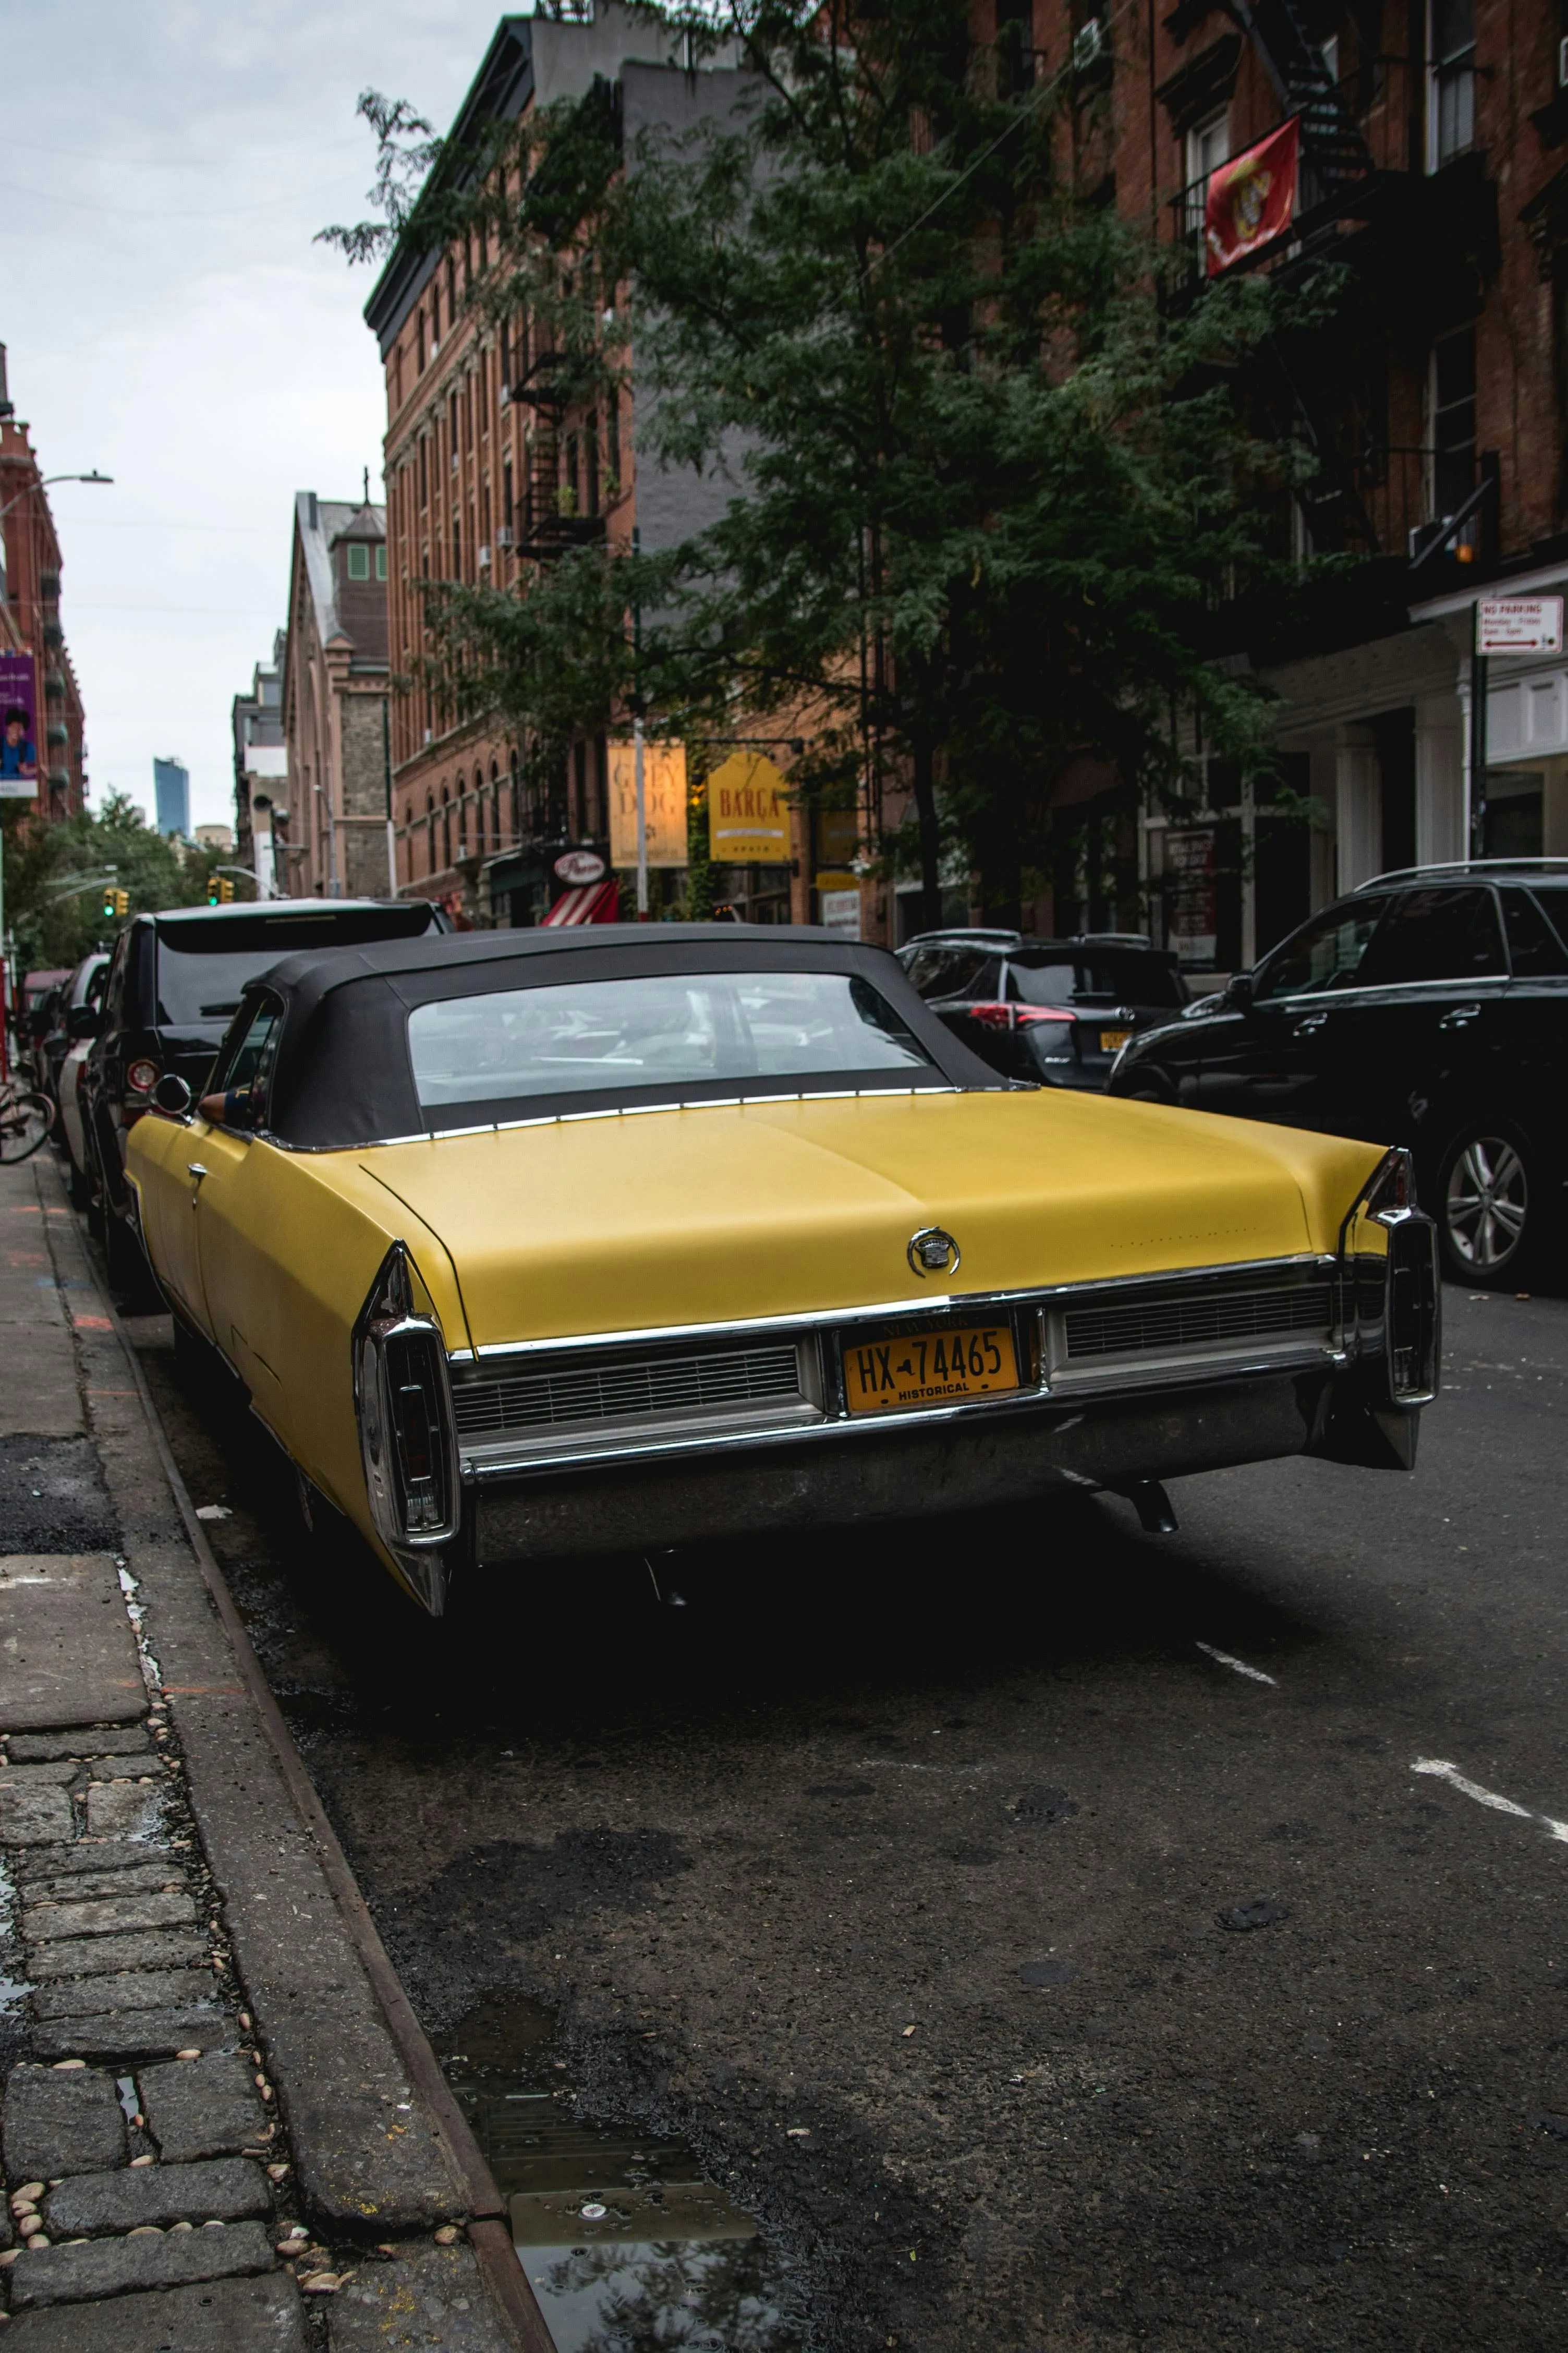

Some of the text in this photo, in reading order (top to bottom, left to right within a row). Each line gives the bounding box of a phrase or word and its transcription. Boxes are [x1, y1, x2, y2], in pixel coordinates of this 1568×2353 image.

[614, 763, 680, 789] GEY
[883, 1314, 968, 1336] NEW YORK
[857, 1331, 1002, 1394] HX 74465
[898, 1382, 970, 1401] HISTORICAL
